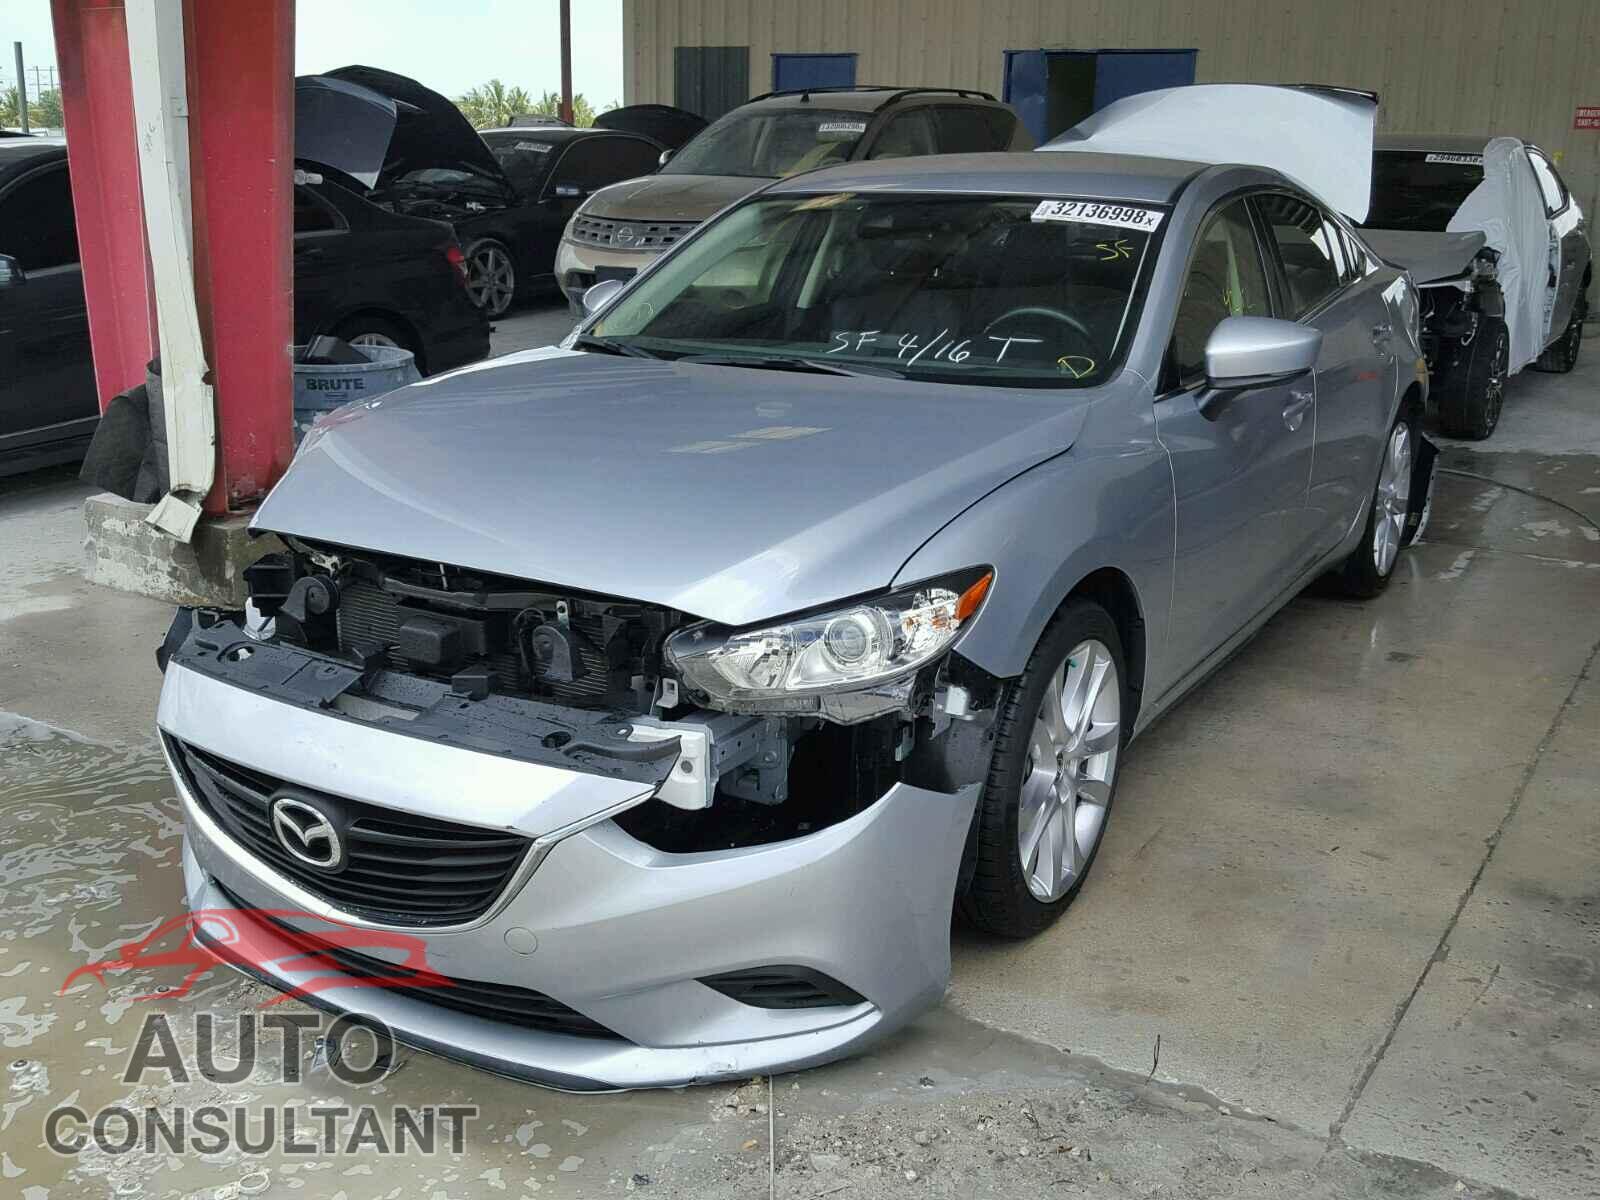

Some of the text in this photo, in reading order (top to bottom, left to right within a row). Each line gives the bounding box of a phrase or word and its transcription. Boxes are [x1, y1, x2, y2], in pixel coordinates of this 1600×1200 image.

[826, 328, 1044, 367] SF 4/16 T
[305, 378, 365, 391] BRUTE
